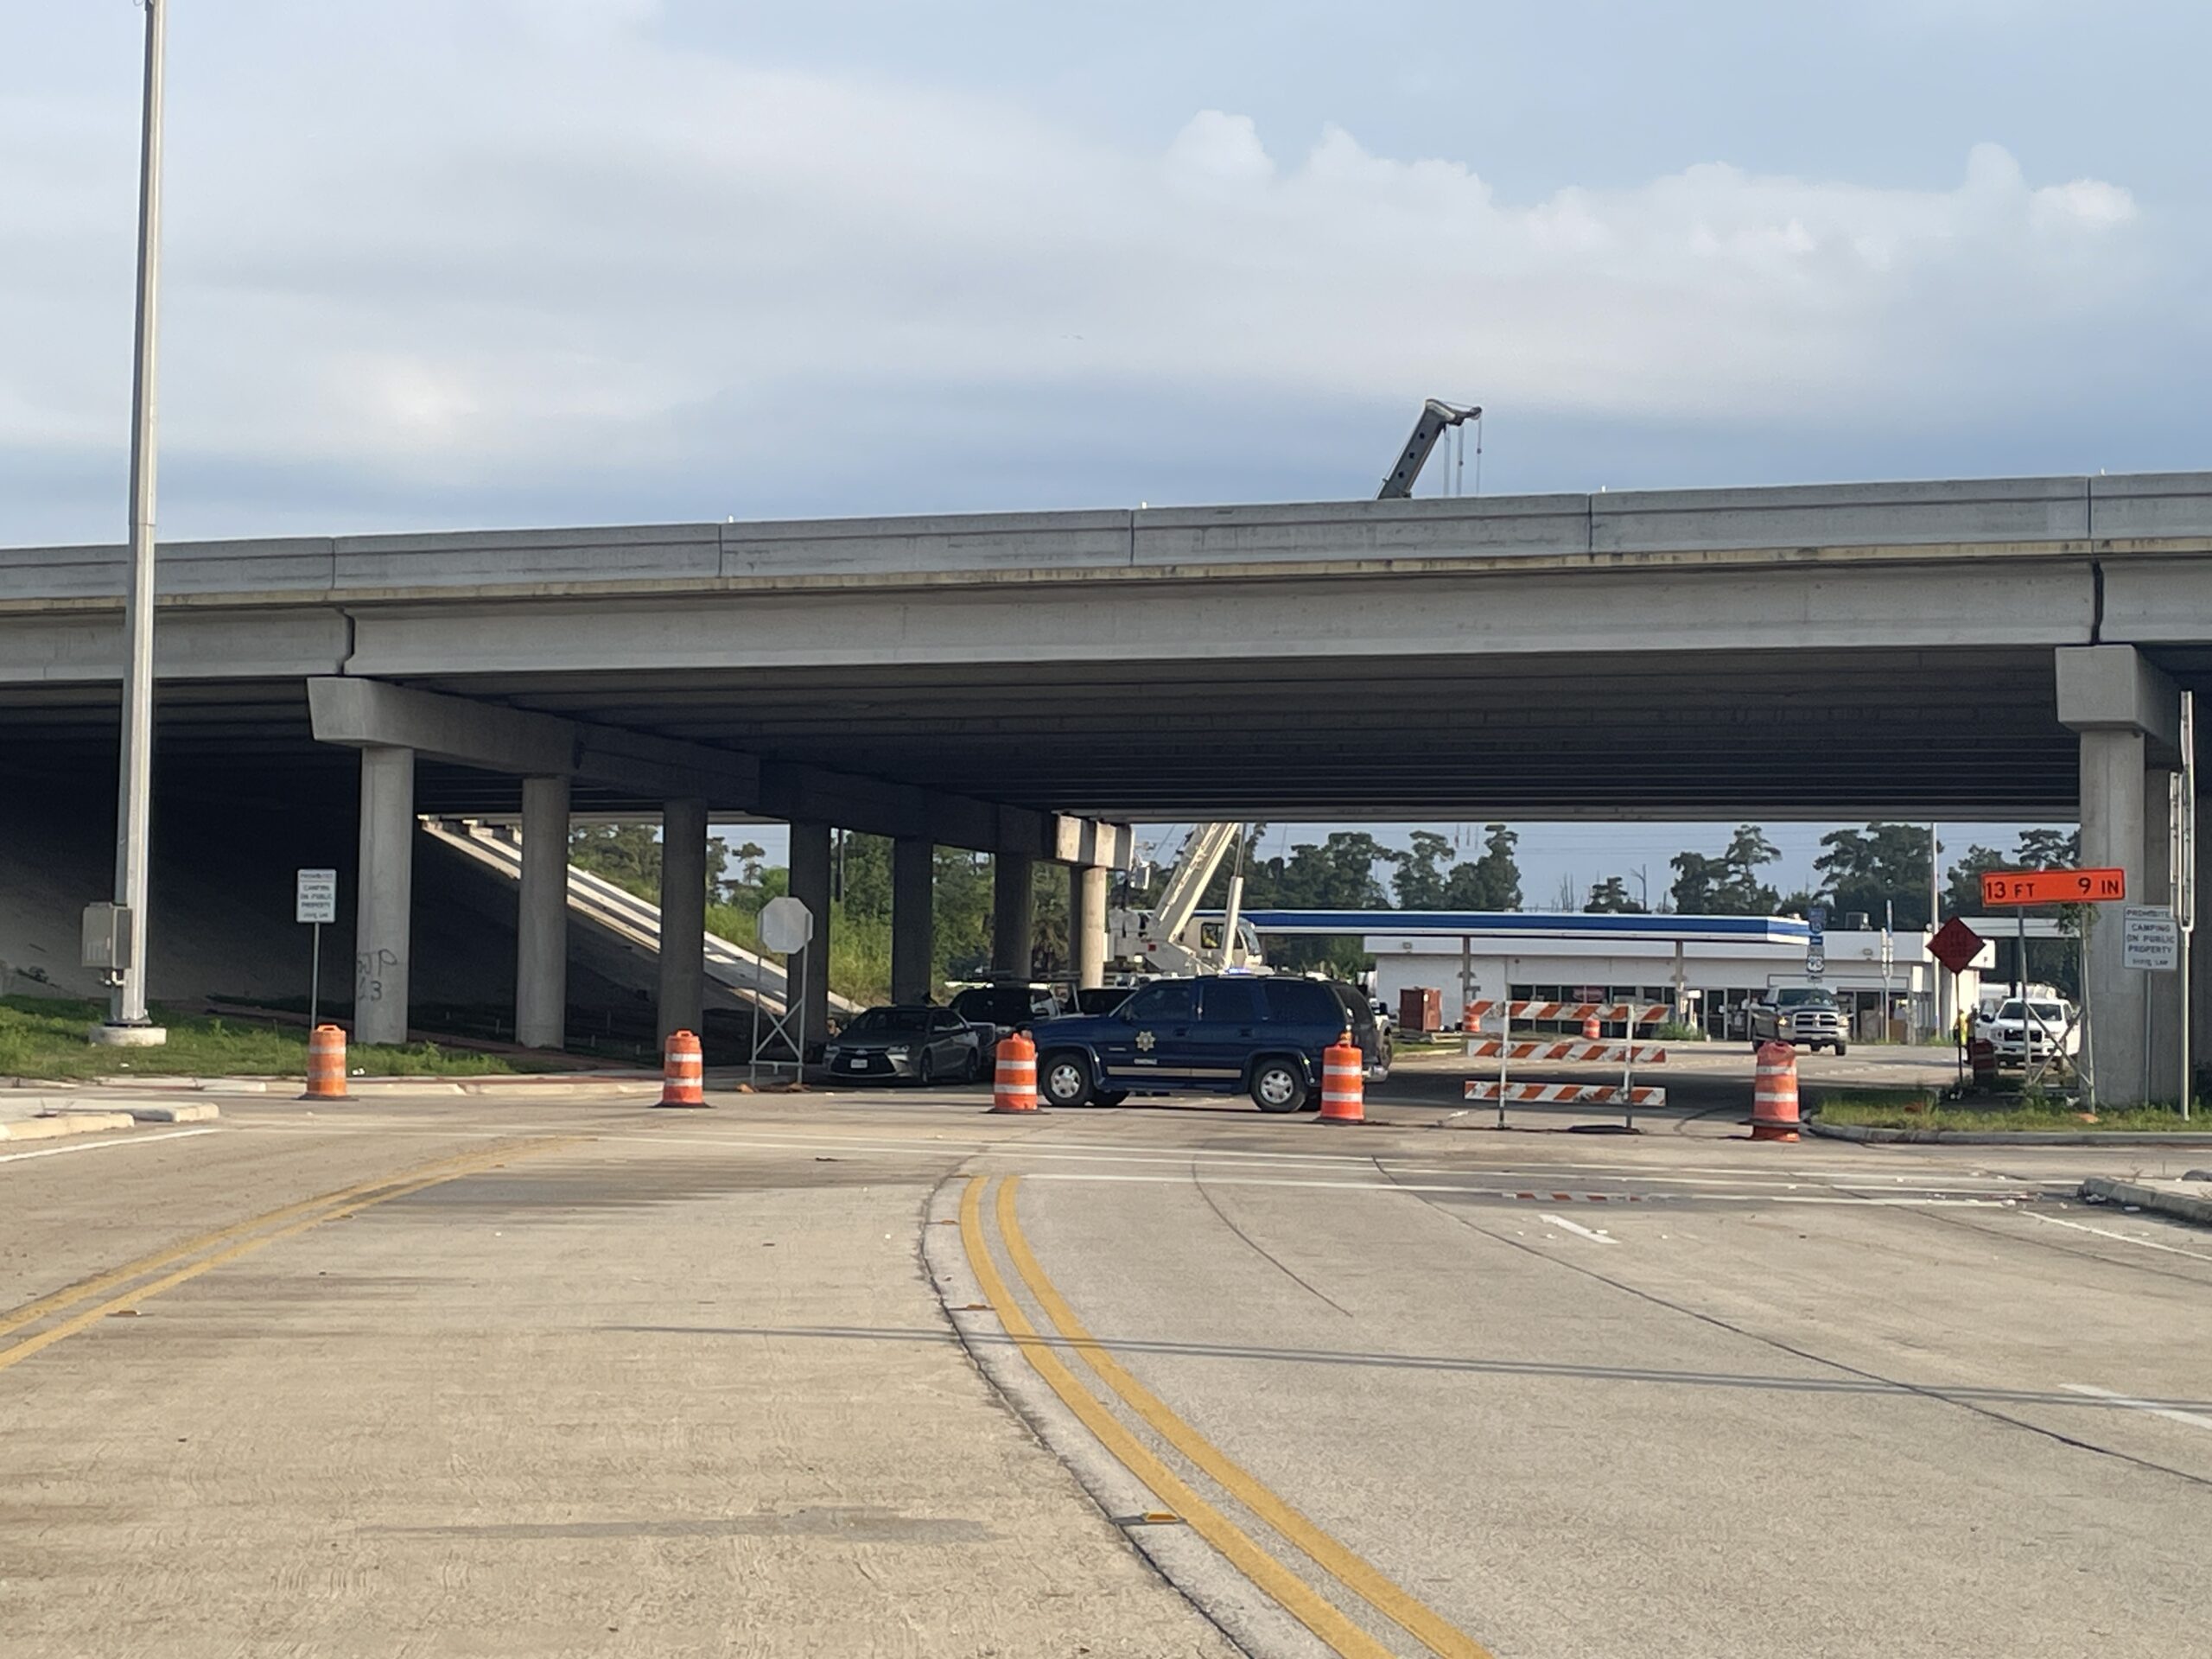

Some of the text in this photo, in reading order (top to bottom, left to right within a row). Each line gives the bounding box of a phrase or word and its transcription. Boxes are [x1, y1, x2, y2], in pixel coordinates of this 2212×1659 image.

[1986, 877, 2119, 899] 13 FT 9 IN
[2131, 923, 2171, 932] CAMPING
[2126, 933, 2176, 944] ON PUBLIC
[2127, 944, 2172, 954] PROPERTY
